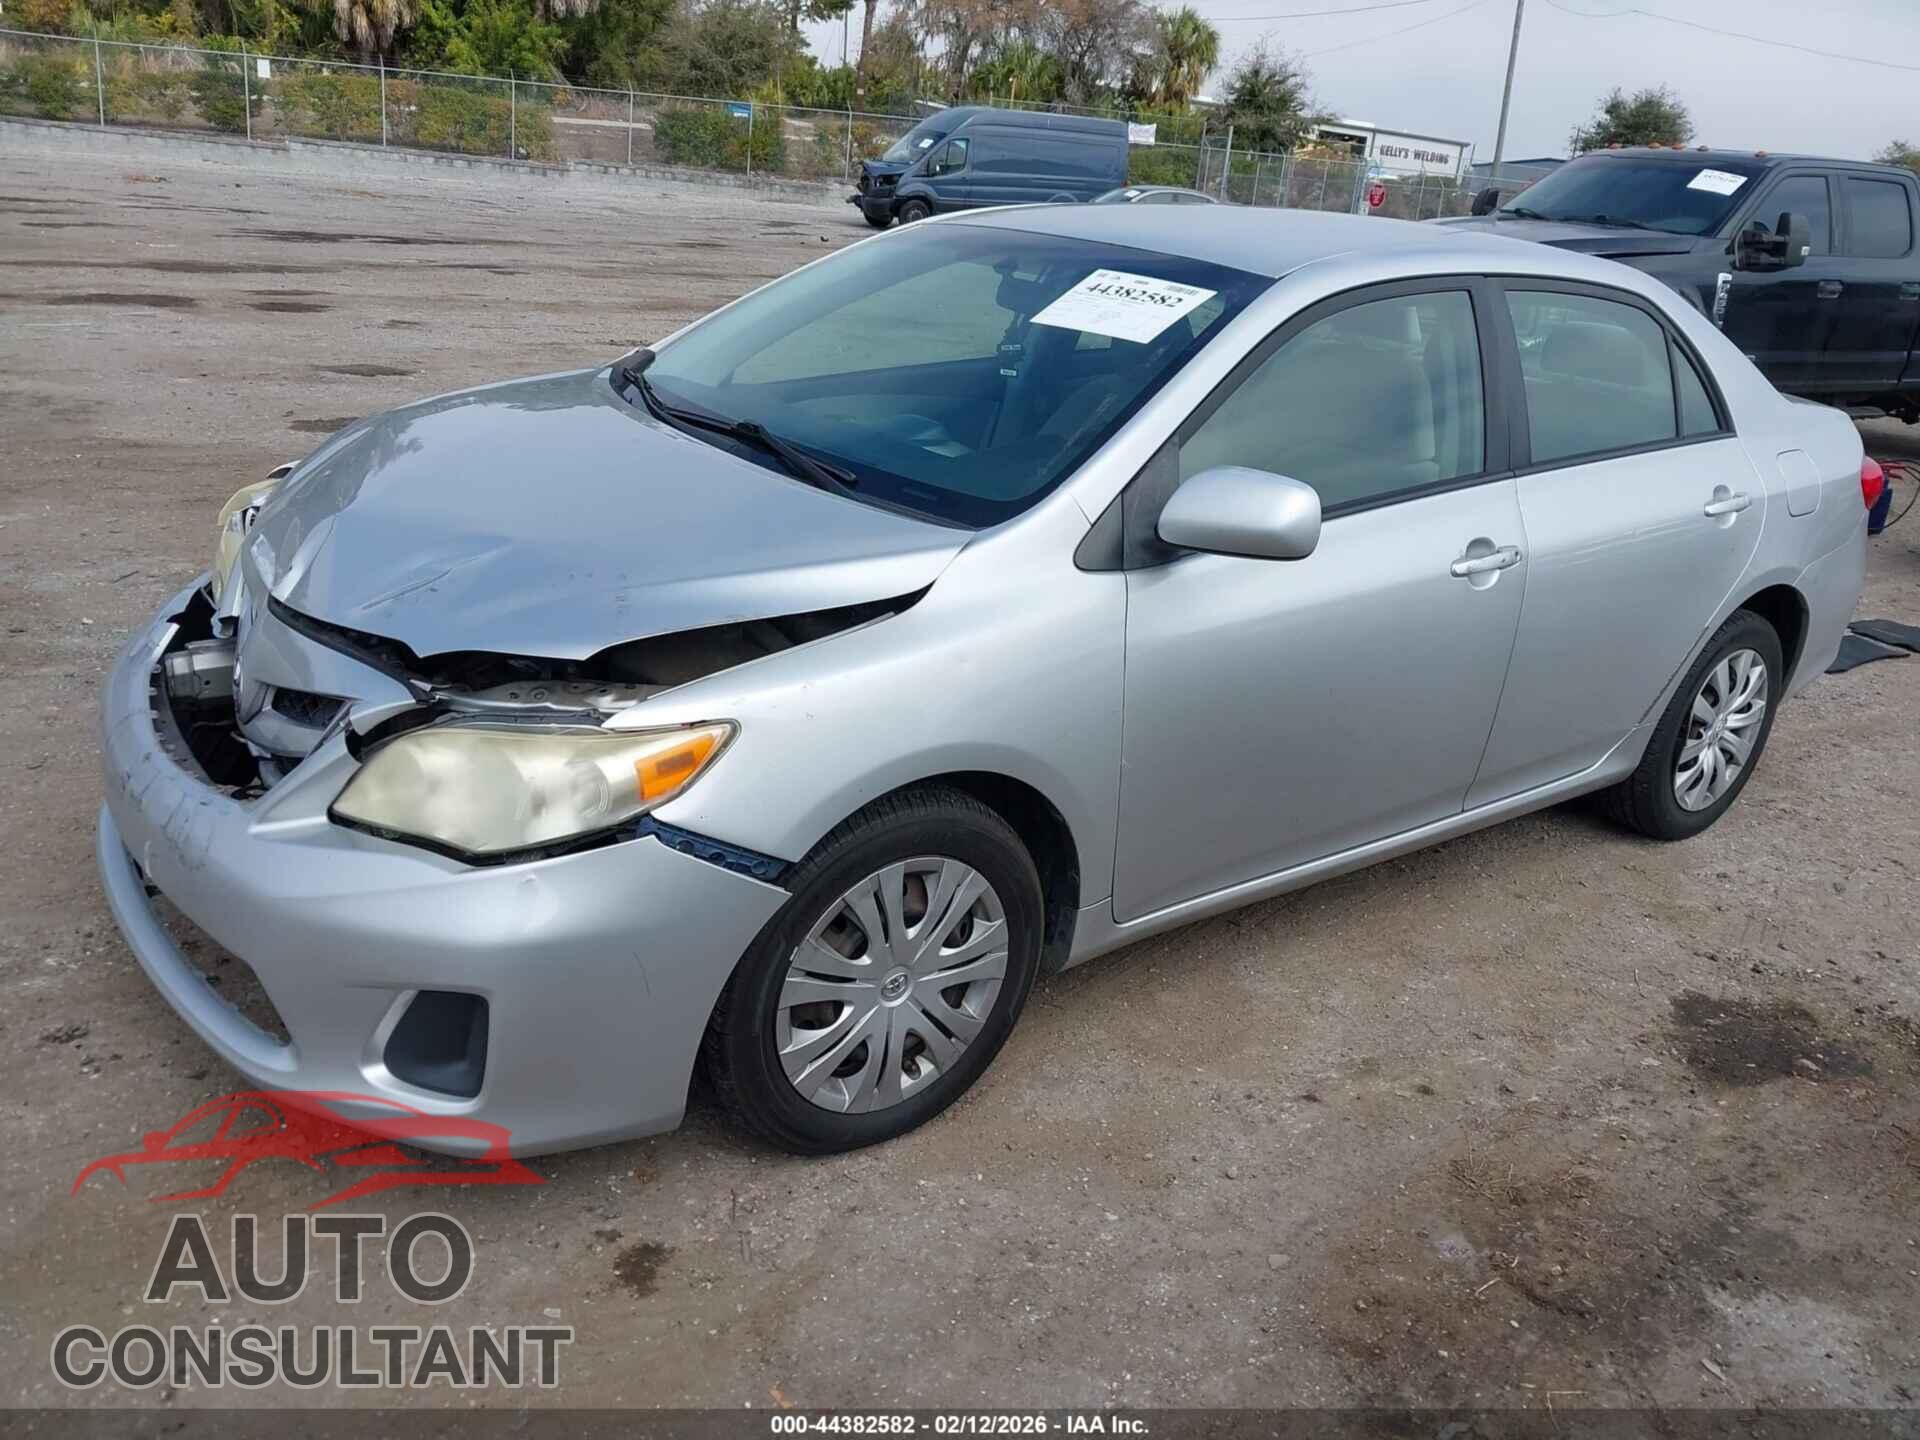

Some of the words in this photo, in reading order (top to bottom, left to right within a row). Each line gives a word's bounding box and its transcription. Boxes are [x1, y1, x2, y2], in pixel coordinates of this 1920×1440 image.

[1380, 144, 1409, 159] KELLY'S
[1413, 149, 1449, 164] WELDING
[1087, 283, 1184, 307] 44382582
